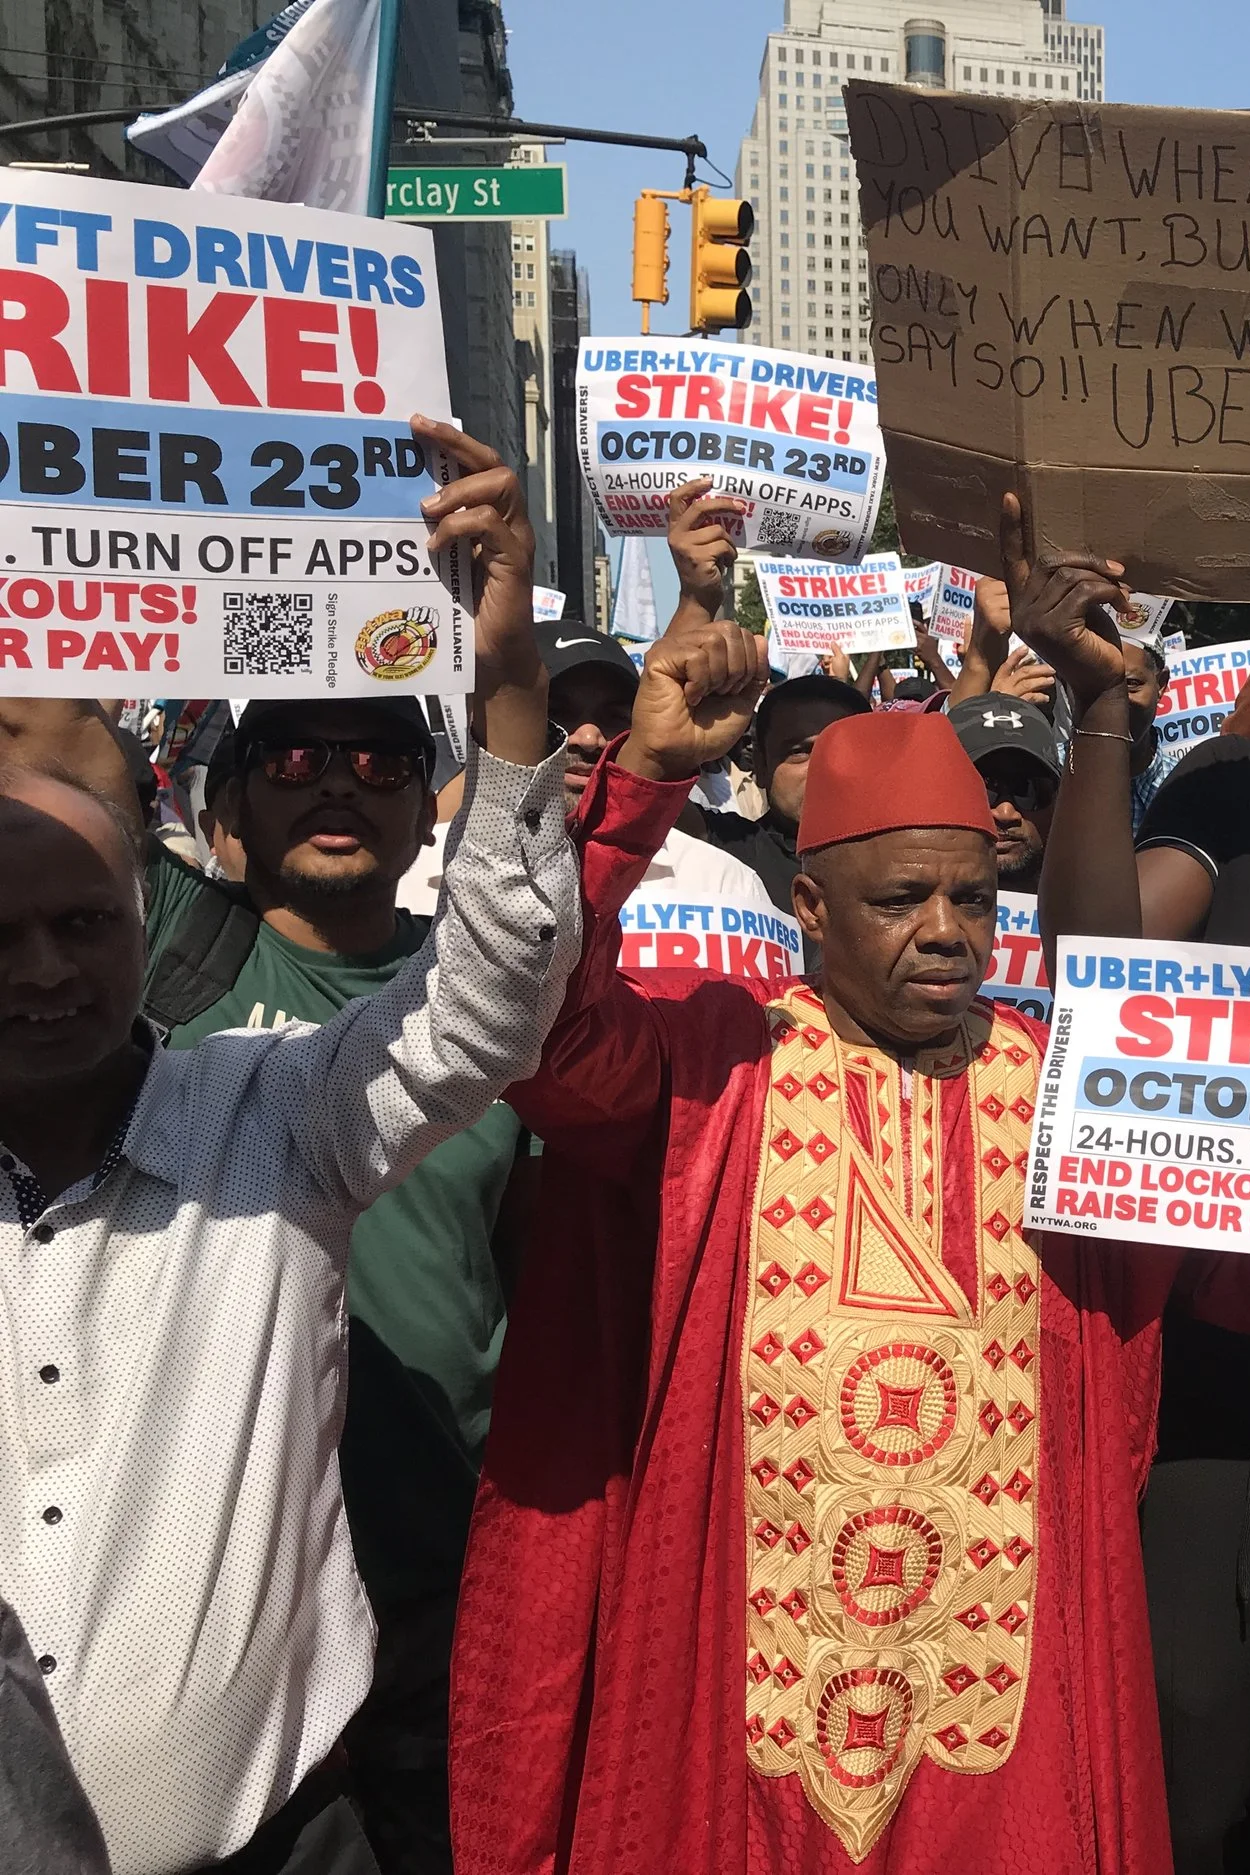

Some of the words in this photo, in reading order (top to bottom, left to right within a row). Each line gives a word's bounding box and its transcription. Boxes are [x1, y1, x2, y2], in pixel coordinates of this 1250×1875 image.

[855, 92, 1094, 192] DRIVE
[473, 178, 501, 206] St
[134, 218, 425, 309] DRIVERS
[875, 264, 977, 324] ONLY
[999, 292, 1196, 352] WHEN
[584, 350, 746, 378] UBER+LYFT
[751, 359, 877, 404] DRIVERS
[880, 323, 957, 386] SAY
[974, 342, 1089, 403] SO!!
[579, 385, 589, 446] DRIVERS!
[615, 373, 854, 445] STRIKE!
[0, 421, 228, 505] BER
[250, 436, 426, 509] 23RD
[579, 447, 592, 473] THE
[600, 430, 776, 473] OCTOBER
[783, 448, 867, 482] 23RD
[586, 475, 614, 527] RESPECT
[604, 494, 641, 511] END
[759, 482, 798, 508] OFF
[800, 491, 857, 519] APPS.
[613, 513, 666, 528] RAISE
[32, 527, 180, 572] TURN
[199, 535, 293, 575] OFF
[304, 539, 432, 576] APPS.
[759, 562, 831, 577] UBER+LYFT
[835, 561, 897, 576] DRIVERS
[0, 578, 197, 624] OUTS!
[327, 592, 338, 617] Sign
[778, 573, 888, 599] STRIKE!
[778, 601, 858, 618] OCTOBER
[862, 595, 899, 614] 23RD
[827, 620, 853, 631] TURN
[854, 619, 873, 629] OFF
[937, 615, 951, 626] END
[327, 618, 338, 650] Strike
[451, 609, 463, 672] ALLIANCE
[781, 629, 801, 638] END
[783, 639, 811, 648] RAISE
[935, 624, 955, 636] RAISE
[47, 630, 181, 672] PAY!
[325, 652, 338, 688] Pledge
[722, 904, 799, 954] DRIVERS
[1046, 1006, 1074, 1080] DRIVERS!
[1041, 1083, 1060, 1118] THE
[1076, 1124, 1243, 1166] 24-HOURS.
[1030, 1121, 1053, 1209] RESPECT
[1058, 1155, 1132, 1187] END
[1031, 1215, 1098, 1231] NYTWA.ORG
[1056, 1187, 1158, 1224] RAISE
[1166, 1199, 1242, 1233] OUR
